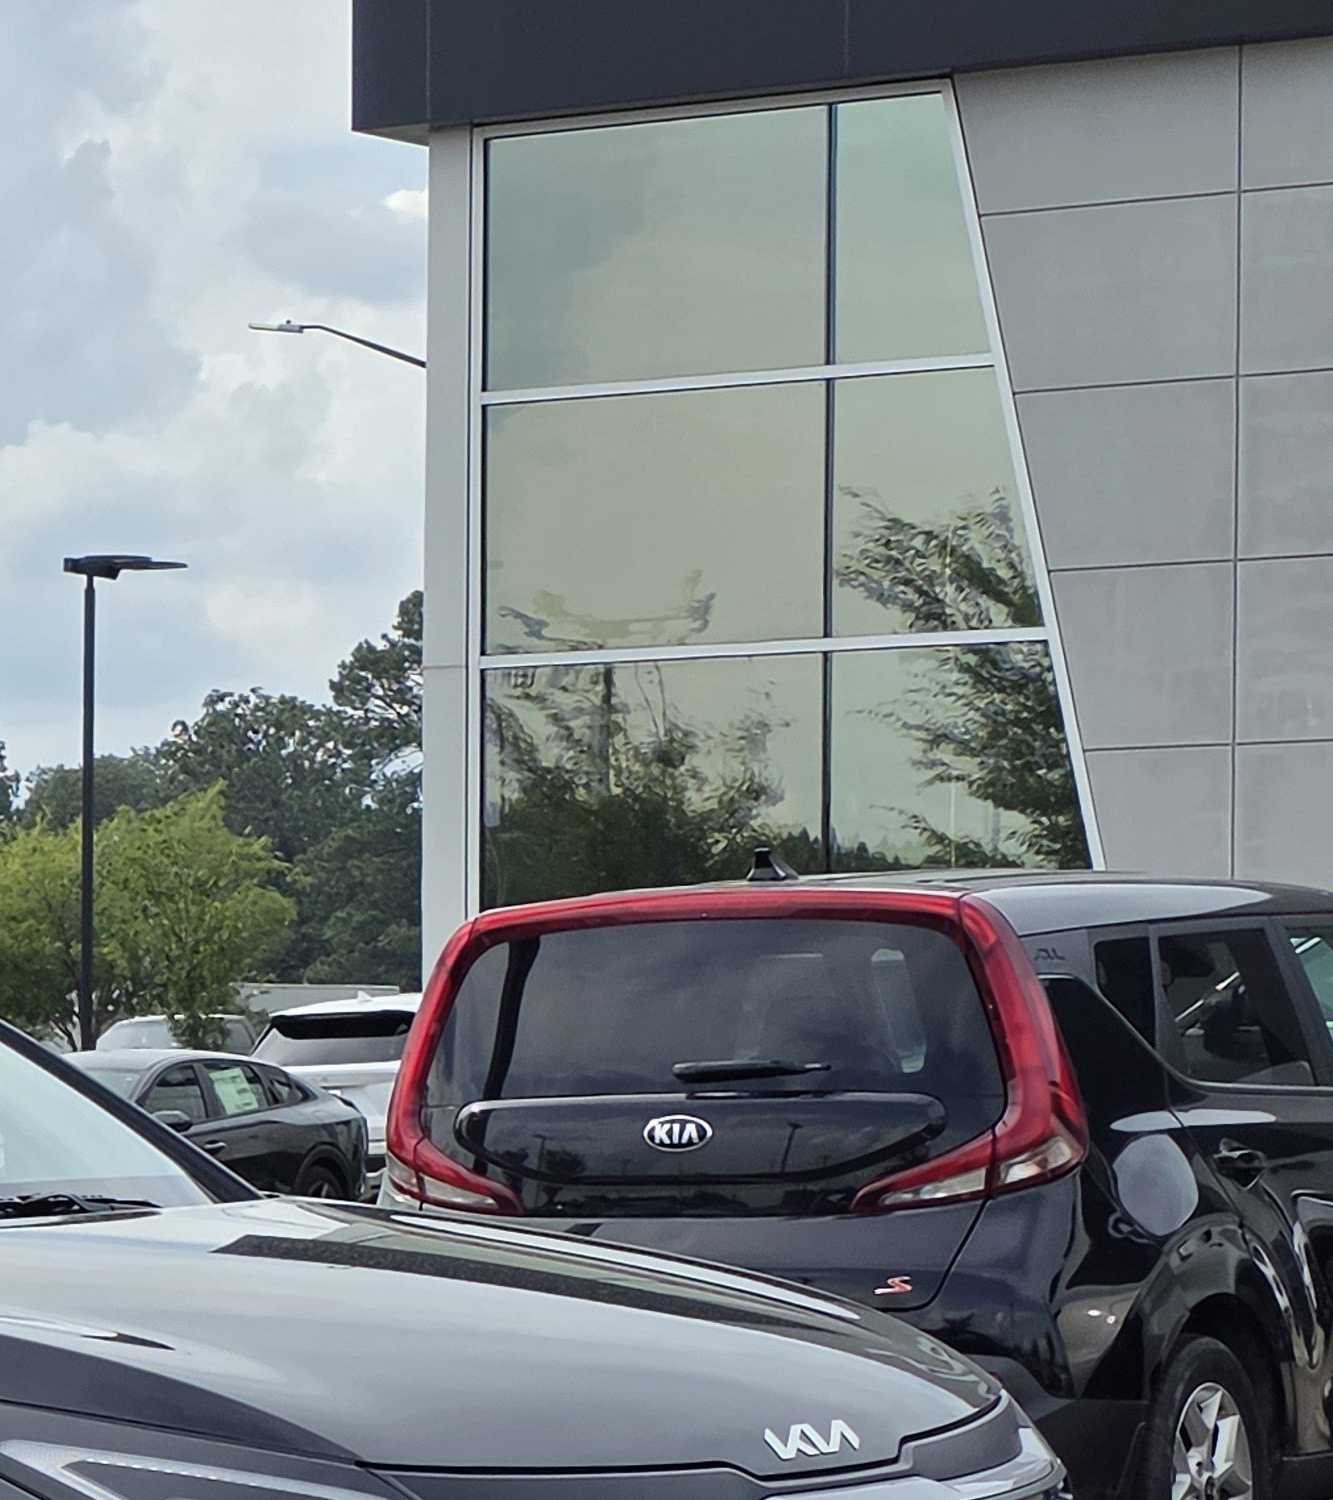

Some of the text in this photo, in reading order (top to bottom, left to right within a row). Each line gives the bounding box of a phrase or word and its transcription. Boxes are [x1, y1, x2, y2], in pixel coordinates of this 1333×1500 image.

[652, 1122, 700, 1145] KIA
[873, 1275, 913, 1295] S
[764, 1419, 861, 1461] KIA
